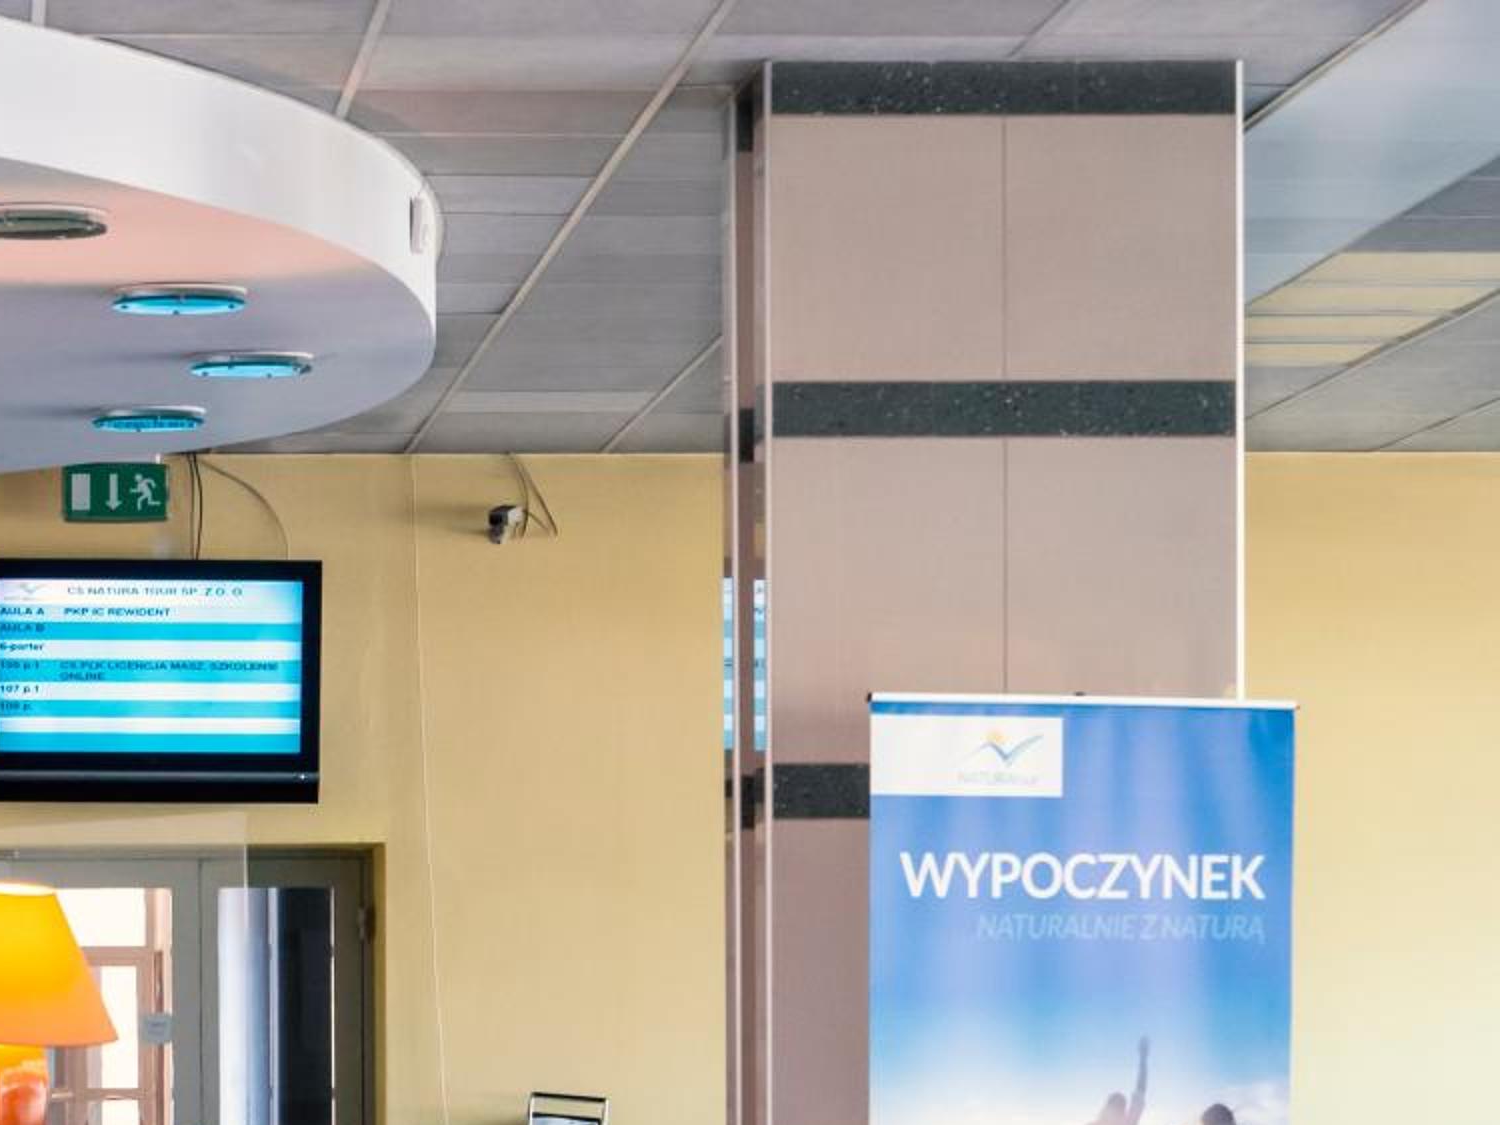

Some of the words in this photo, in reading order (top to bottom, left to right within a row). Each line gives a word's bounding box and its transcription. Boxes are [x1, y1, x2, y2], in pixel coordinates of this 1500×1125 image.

[0, 607, 32, 615] AULA
[63, 607, 89, 617] PKP
[899, 851, 1266, 901] WYPOCZYNEK
[978, 911, 1136, 943] NATURALNIE
[1139, 912, 1157, 940] Z
[1161, 912, 1266, 944] NATURĄ
